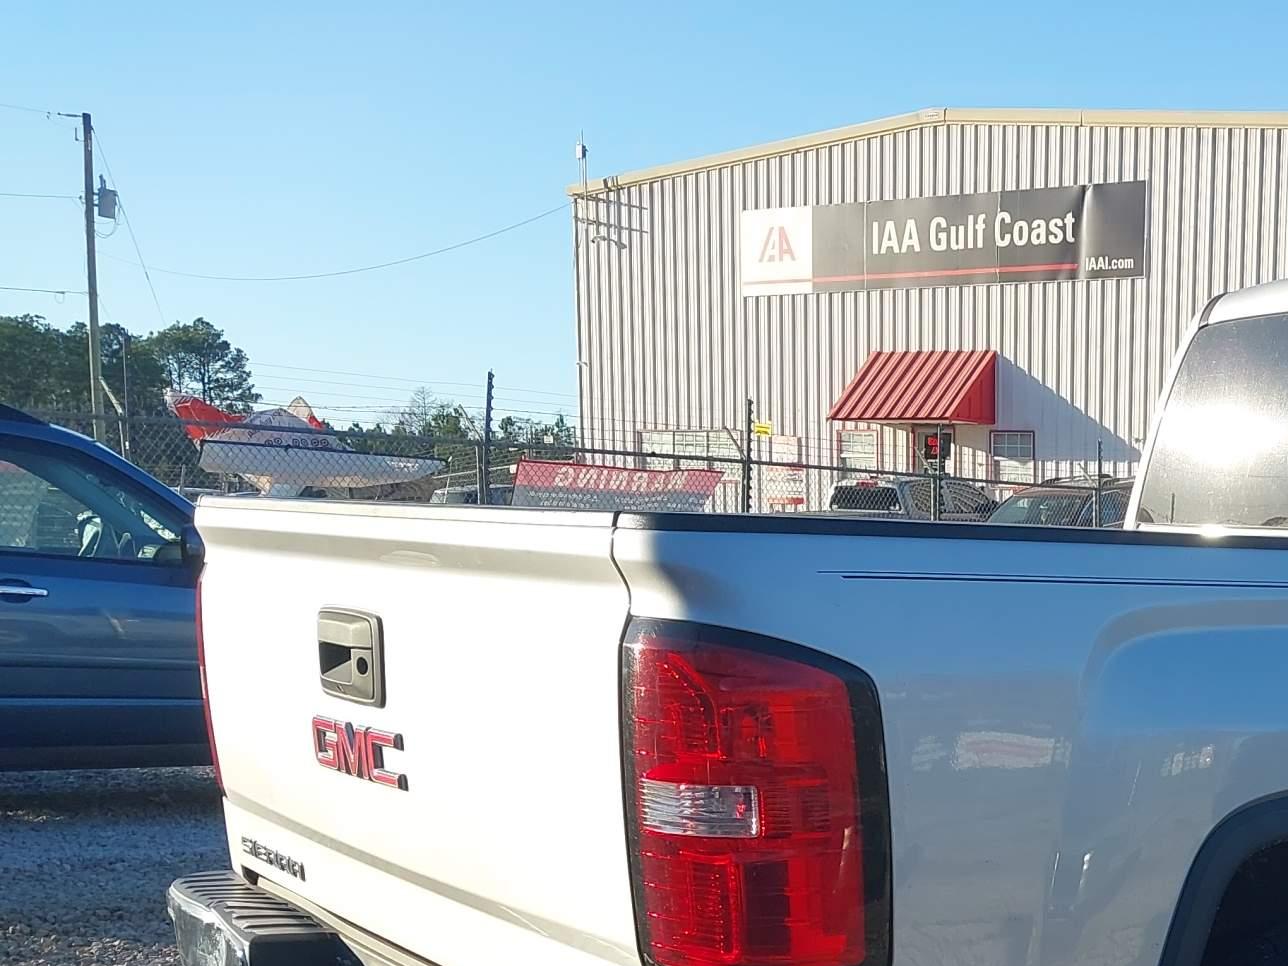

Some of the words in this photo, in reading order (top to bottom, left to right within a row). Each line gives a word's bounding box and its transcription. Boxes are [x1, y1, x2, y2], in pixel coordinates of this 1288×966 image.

[872, 219, 920, 255] IAA
[929, 213, 986, 252] Gulf
[995, 210, 1076, 248] Coast
[1085, 256, 1134, 272] IAAI.com
[312, 714, 409, 791] GMC
[242, 837, 306, 881] SIERRA
